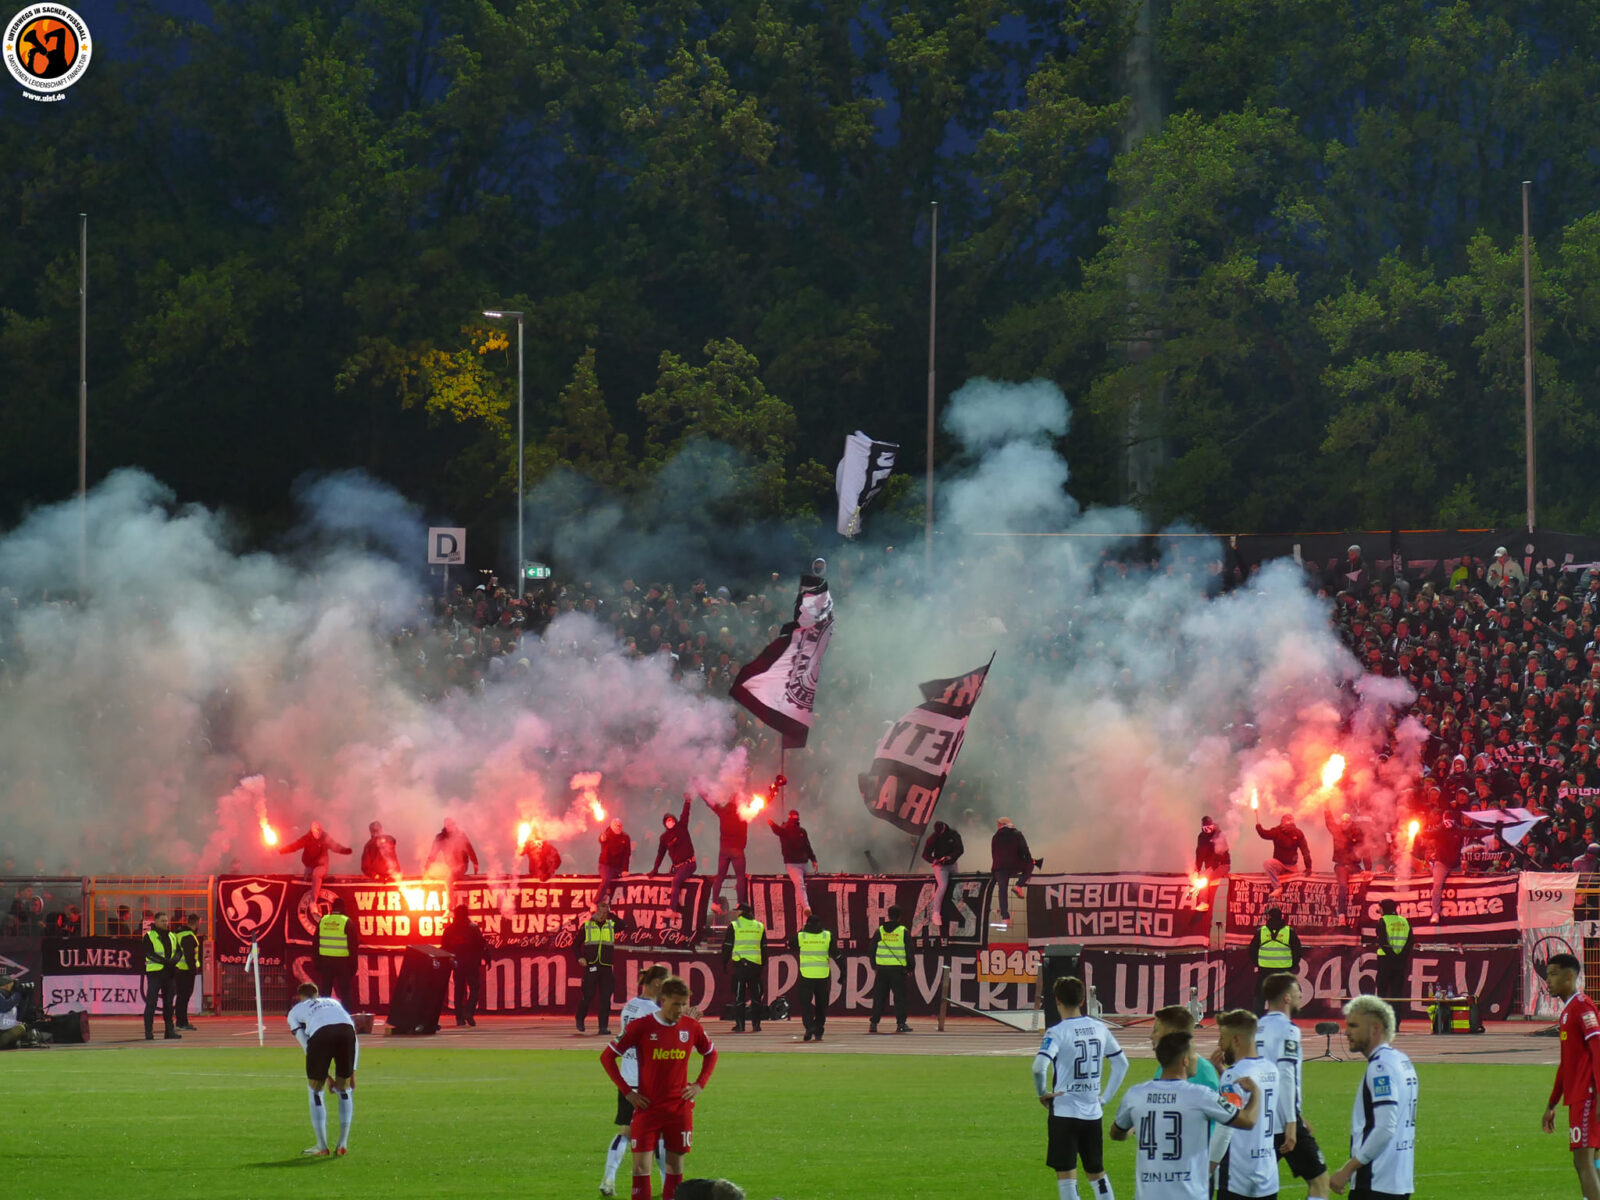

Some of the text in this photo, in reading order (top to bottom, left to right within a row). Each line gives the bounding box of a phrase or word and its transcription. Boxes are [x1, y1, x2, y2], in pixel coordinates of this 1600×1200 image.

[436, 533, 458, 558] D
[354, 891, 402, 911] WIR
[1528, 890, 1563, 901] 1999
[358, 915, 411, 937] UND
[1067, 912, 1174, 936] IMPERO
[59, 949, 132, 968] ULMER
[979, 950, 1041, 975] 1946
[52, 987, 138, 1004] SPATZEN
[652, 1048, 686, 1060] Netto
[1074, 1039, 1101, 1080] 23
[681, 1131, 693, 1148] 10
[1139, 1110, 1182, 1161] 43
[1165, 1171, 1191, 1182] UTZ
